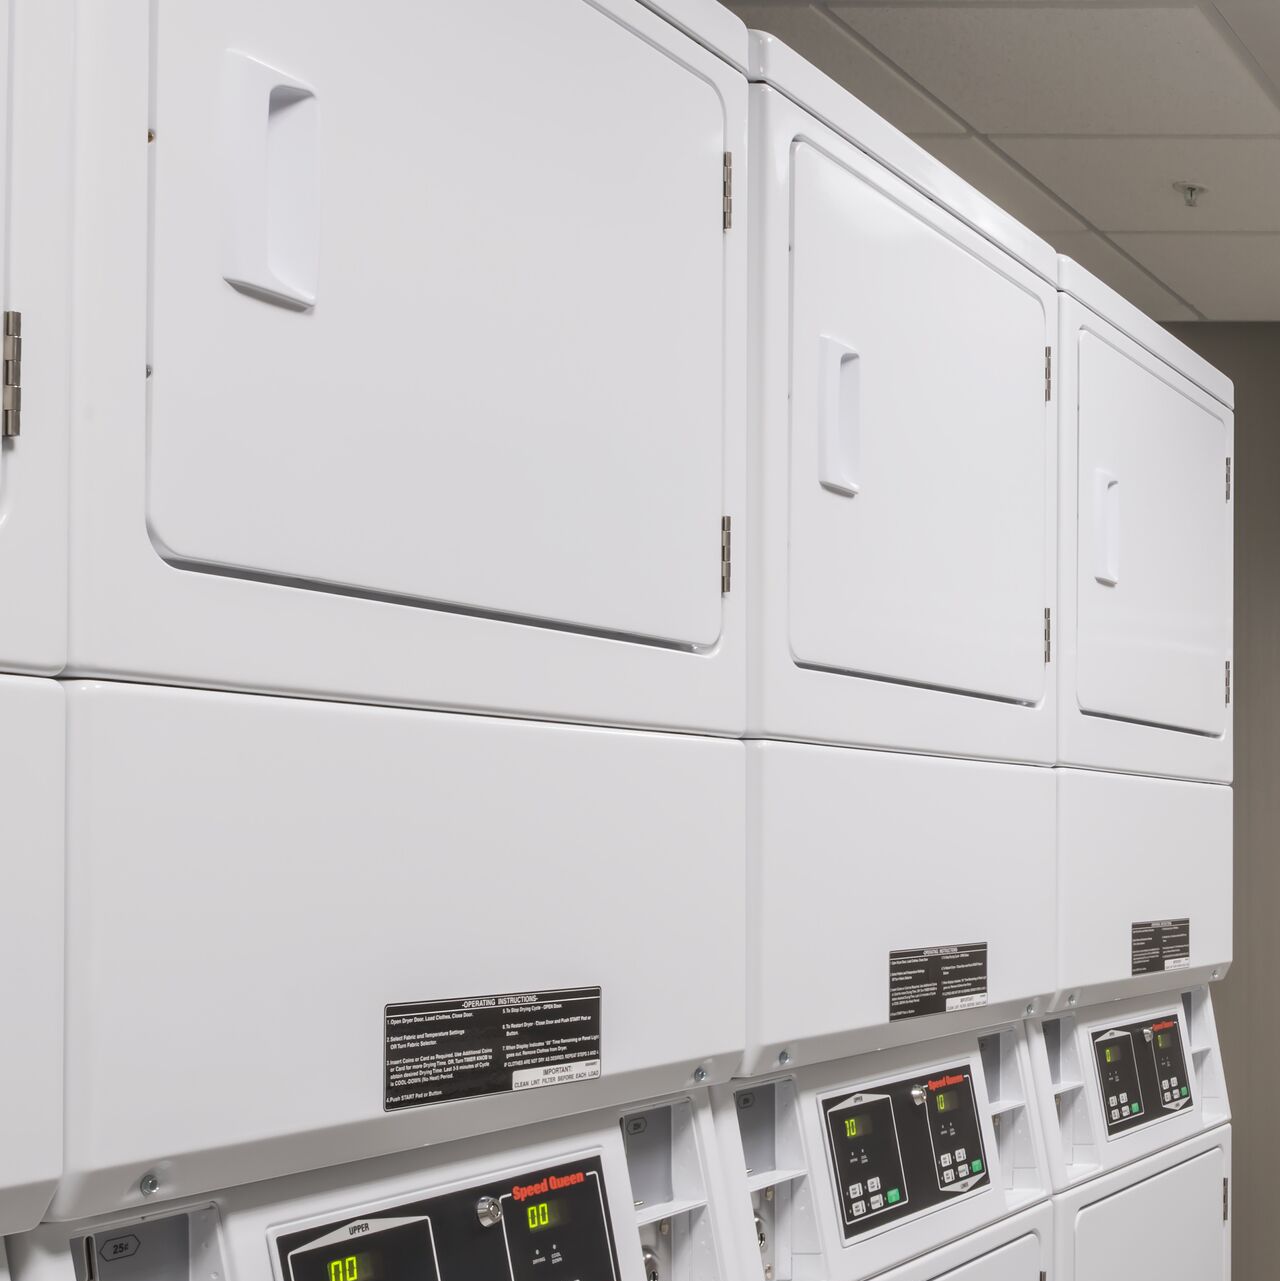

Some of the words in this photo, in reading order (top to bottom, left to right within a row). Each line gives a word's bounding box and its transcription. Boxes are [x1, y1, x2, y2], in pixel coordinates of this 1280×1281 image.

[514, 1080, 529, 1088] CLEAN
[542, 1076, 556, 1084] FILTER
[512, 1181, 549, 1201] Speed
[549, 1172, 584, 1190] Queen
[348, 1223, 369, 1235] UPPER
